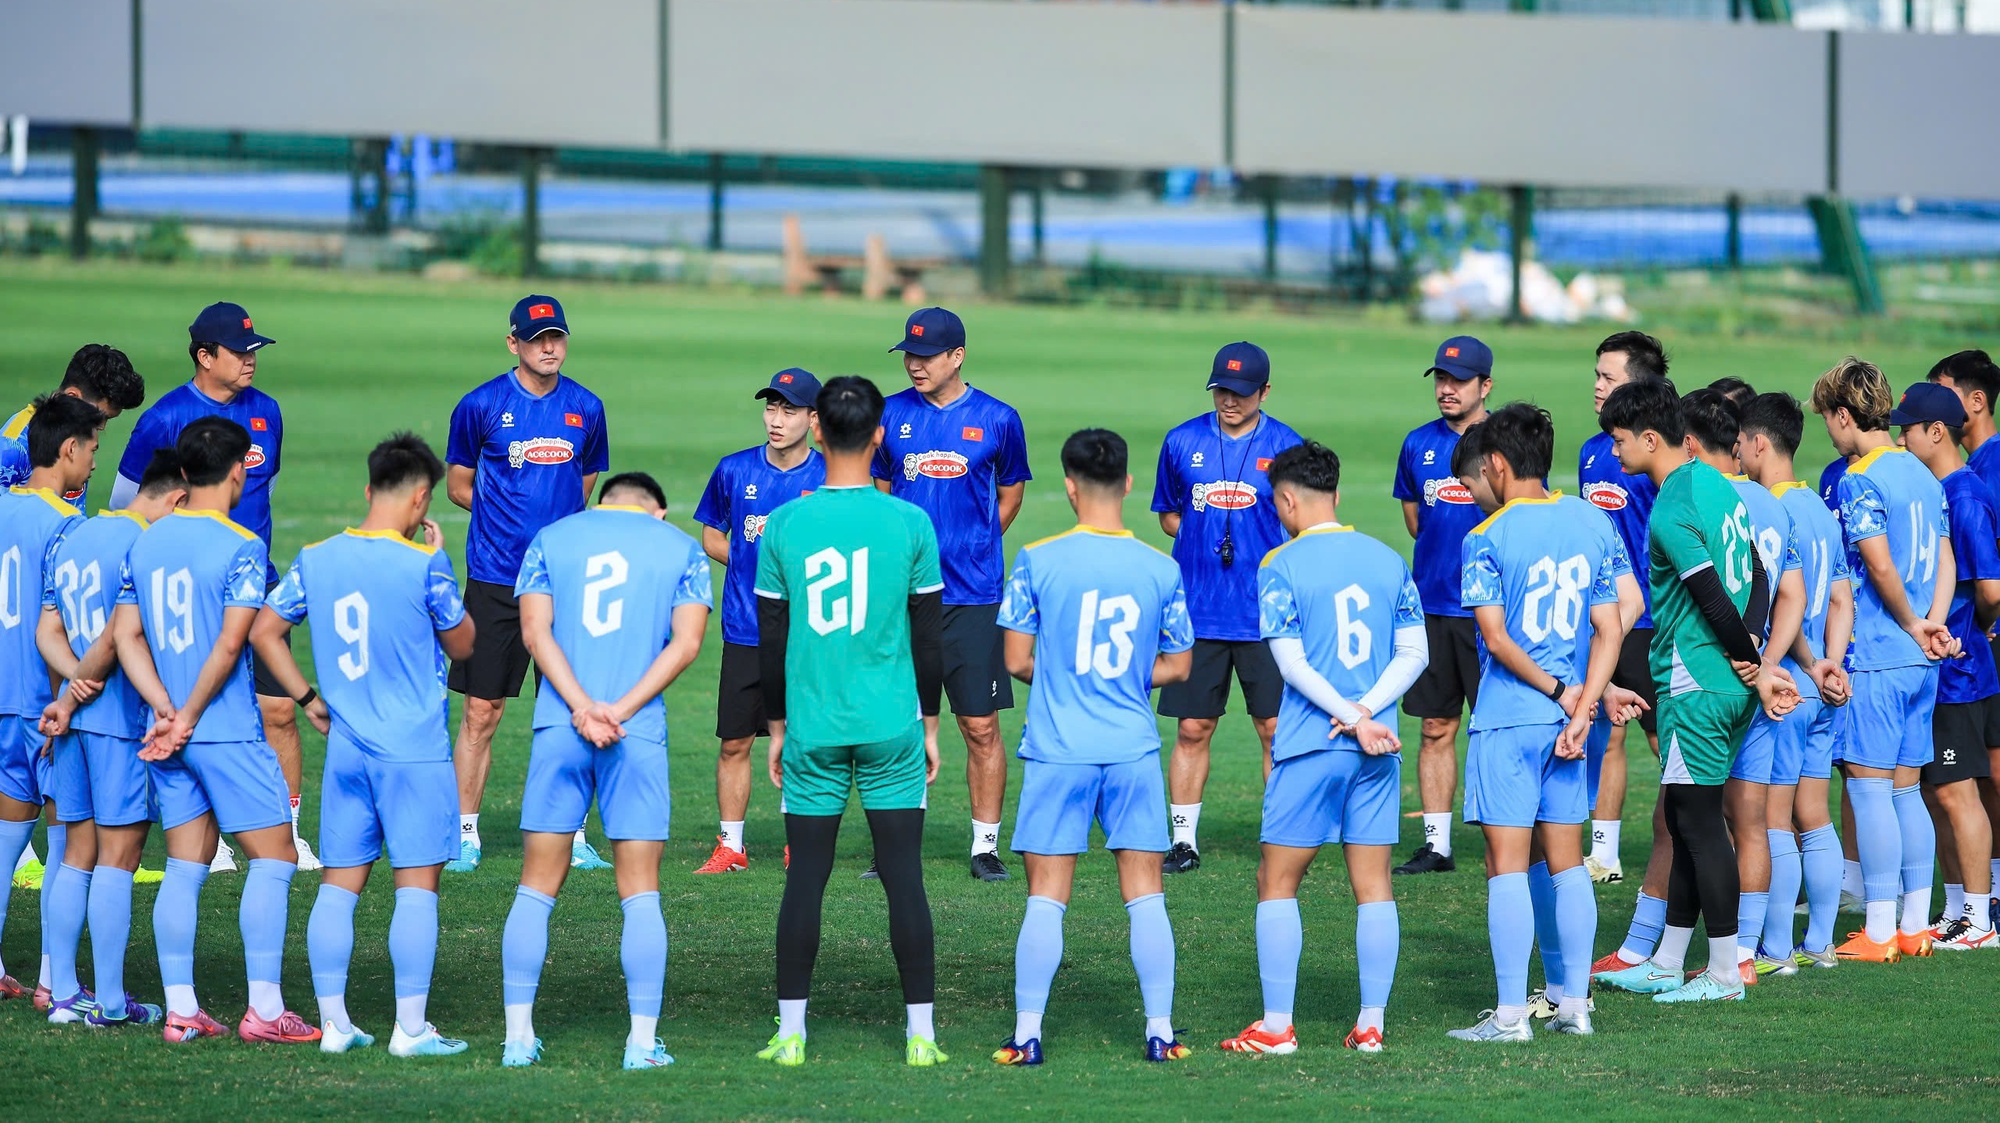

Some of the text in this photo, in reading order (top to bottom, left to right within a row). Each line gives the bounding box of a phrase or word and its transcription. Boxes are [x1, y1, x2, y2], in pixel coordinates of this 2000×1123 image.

[523, 438, 573, 449] Cook happiness
[917, 451, 967, 464] Cook happiness
[1205, 481, 1222, 491] Cook
[1721, 501, 1752, 595] 25
[1811, 537, 1828, 619] 11
[1905, 500, 1936, 584] 14
[55, 559, 105, 645] 32
[151, 566, 195, 655] 19
[582, 550, 629, 638] 2
[804, 546, 869, 637] 21
[1075, 588, 1141, 679] 13
[1334, 583, 1372, 671] 6
[1521, 553, 1591, 644] 28
[334, 590, 369, 682] 9
